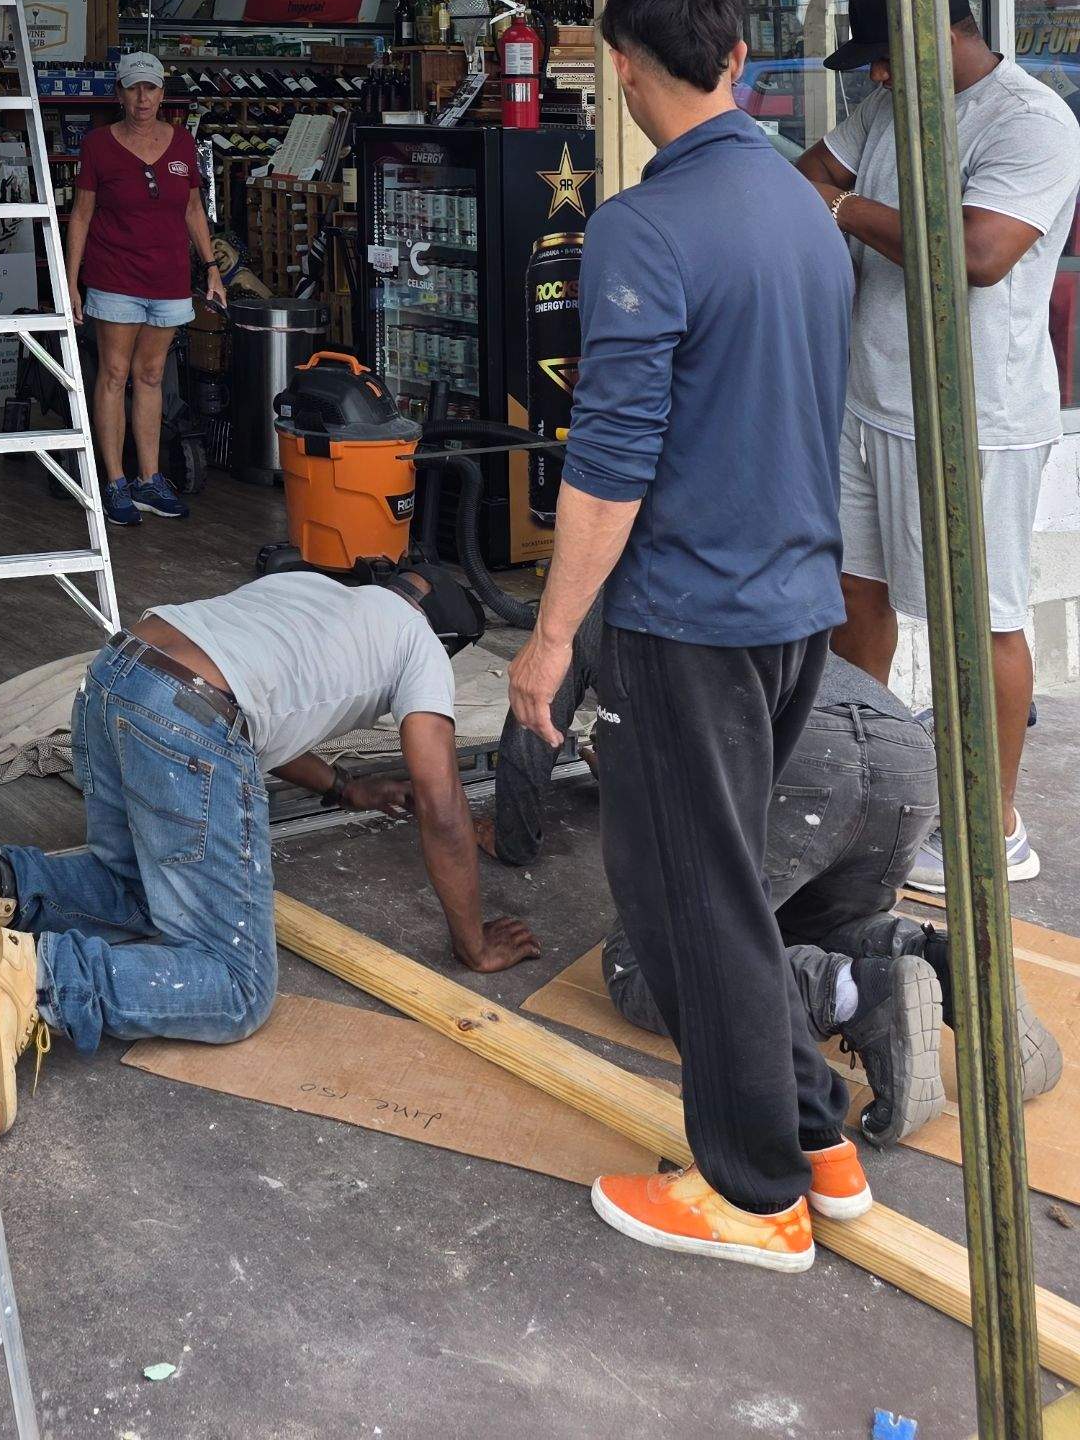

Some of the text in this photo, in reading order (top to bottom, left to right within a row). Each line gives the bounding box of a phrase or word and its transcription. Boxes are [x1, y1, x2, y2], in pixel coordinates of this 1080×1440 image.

[411, 151, 444, 163] ENERGY
[407, 278, 435, 291] CELSIUS
[535, 299, 564, 314] ENERGY
